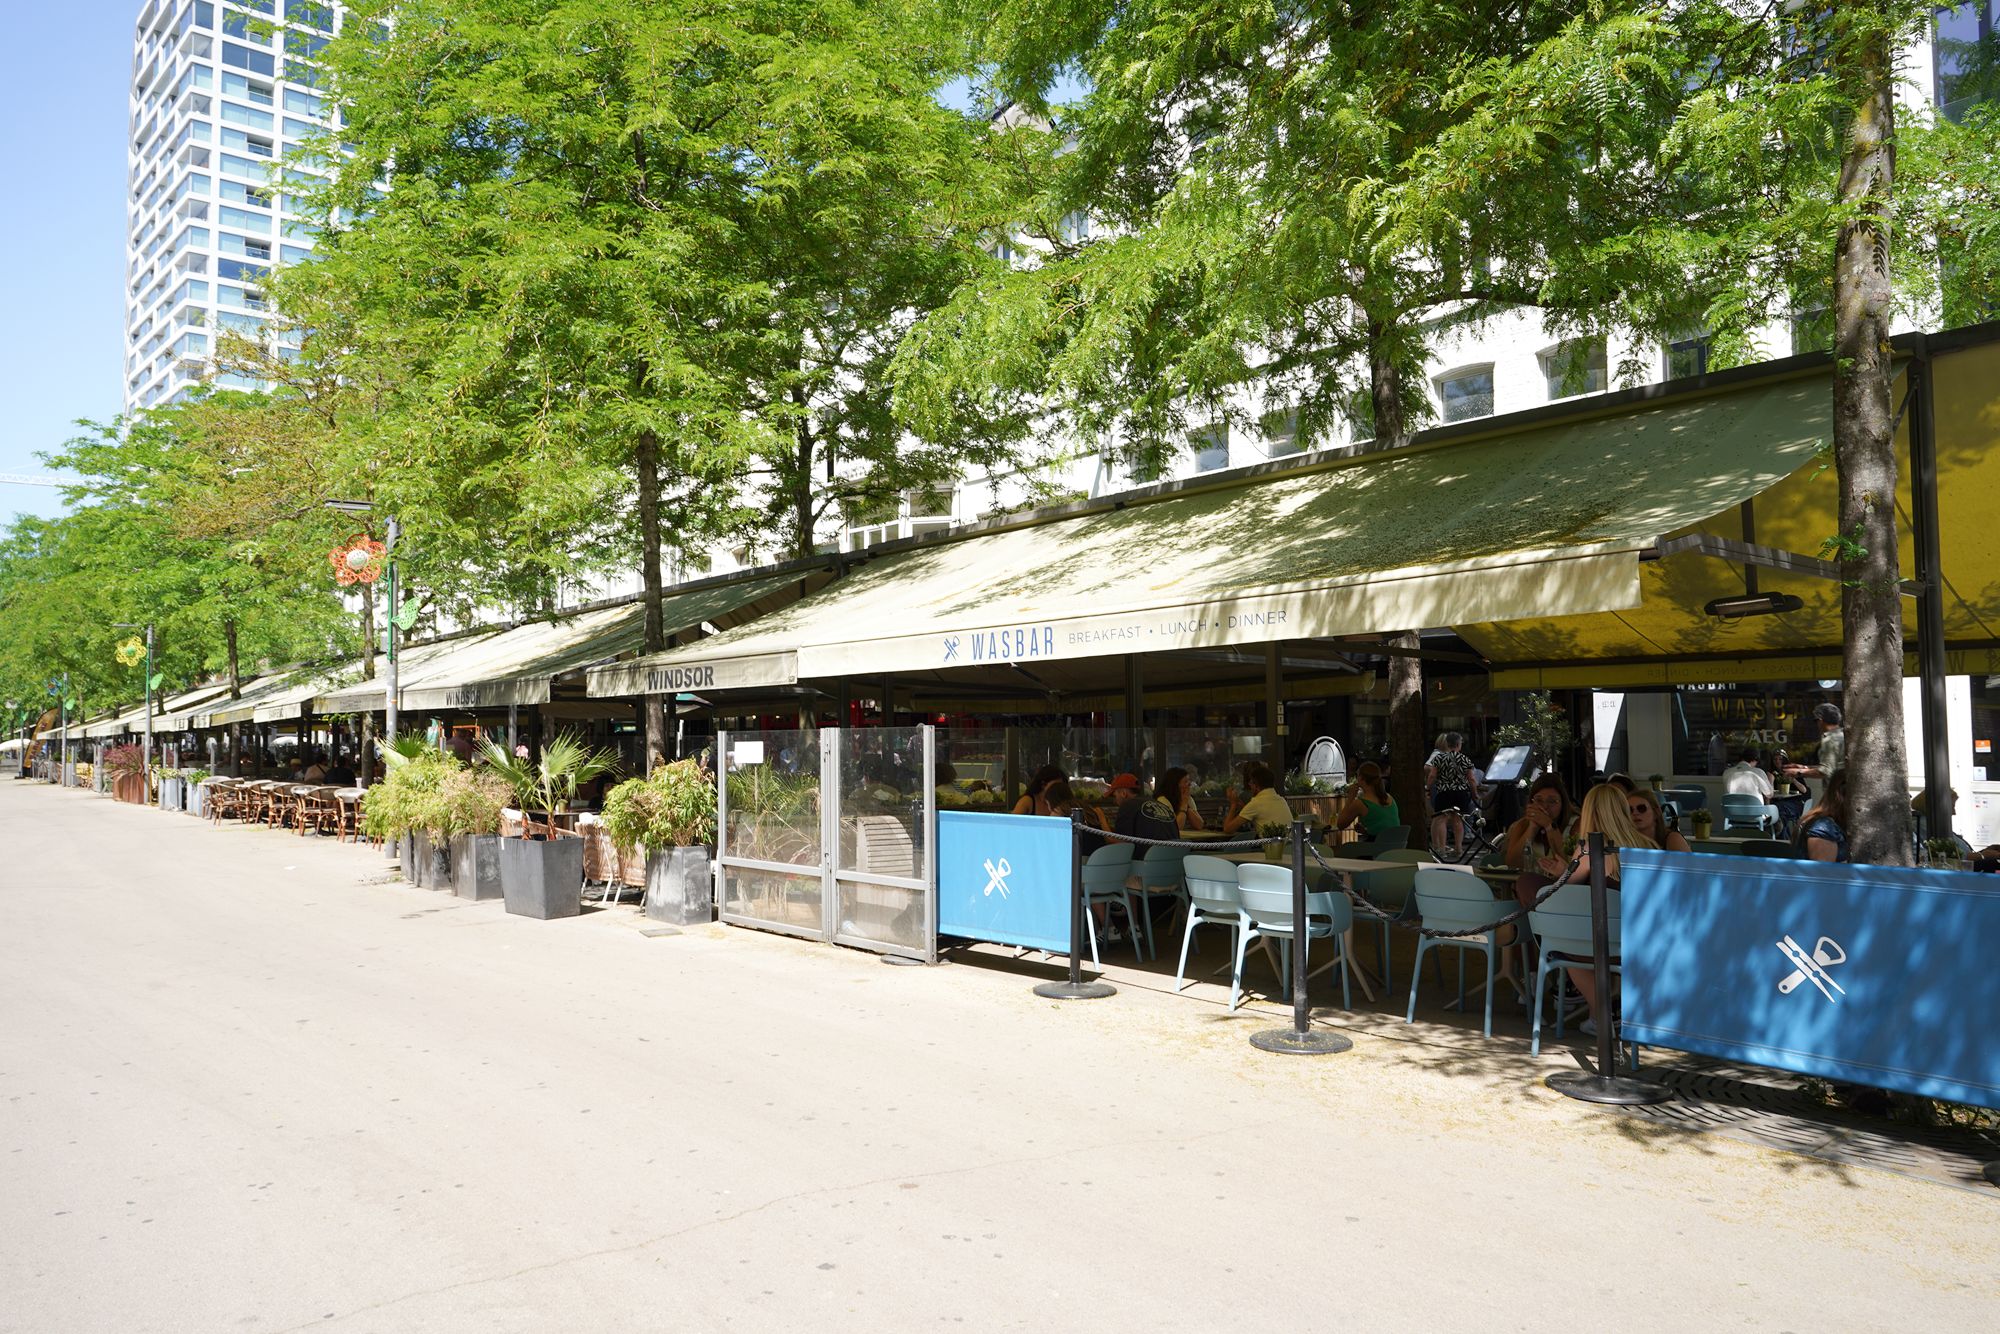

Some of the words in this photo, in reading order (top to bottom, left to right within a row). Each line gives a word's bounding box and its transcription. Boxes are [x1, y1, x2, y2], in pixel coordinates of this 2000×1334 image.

[1068, 626, 1142, 645] BREAKFAST
[1160, 619, 1207, 635] LUNCH
[1228, 610, 1288, 630] DINNER
[971, 626, 1054, 661] WASBAR
[647, 666, 715, 691] WINDSOR
[445, 690, 482, 706] WINDSOR
